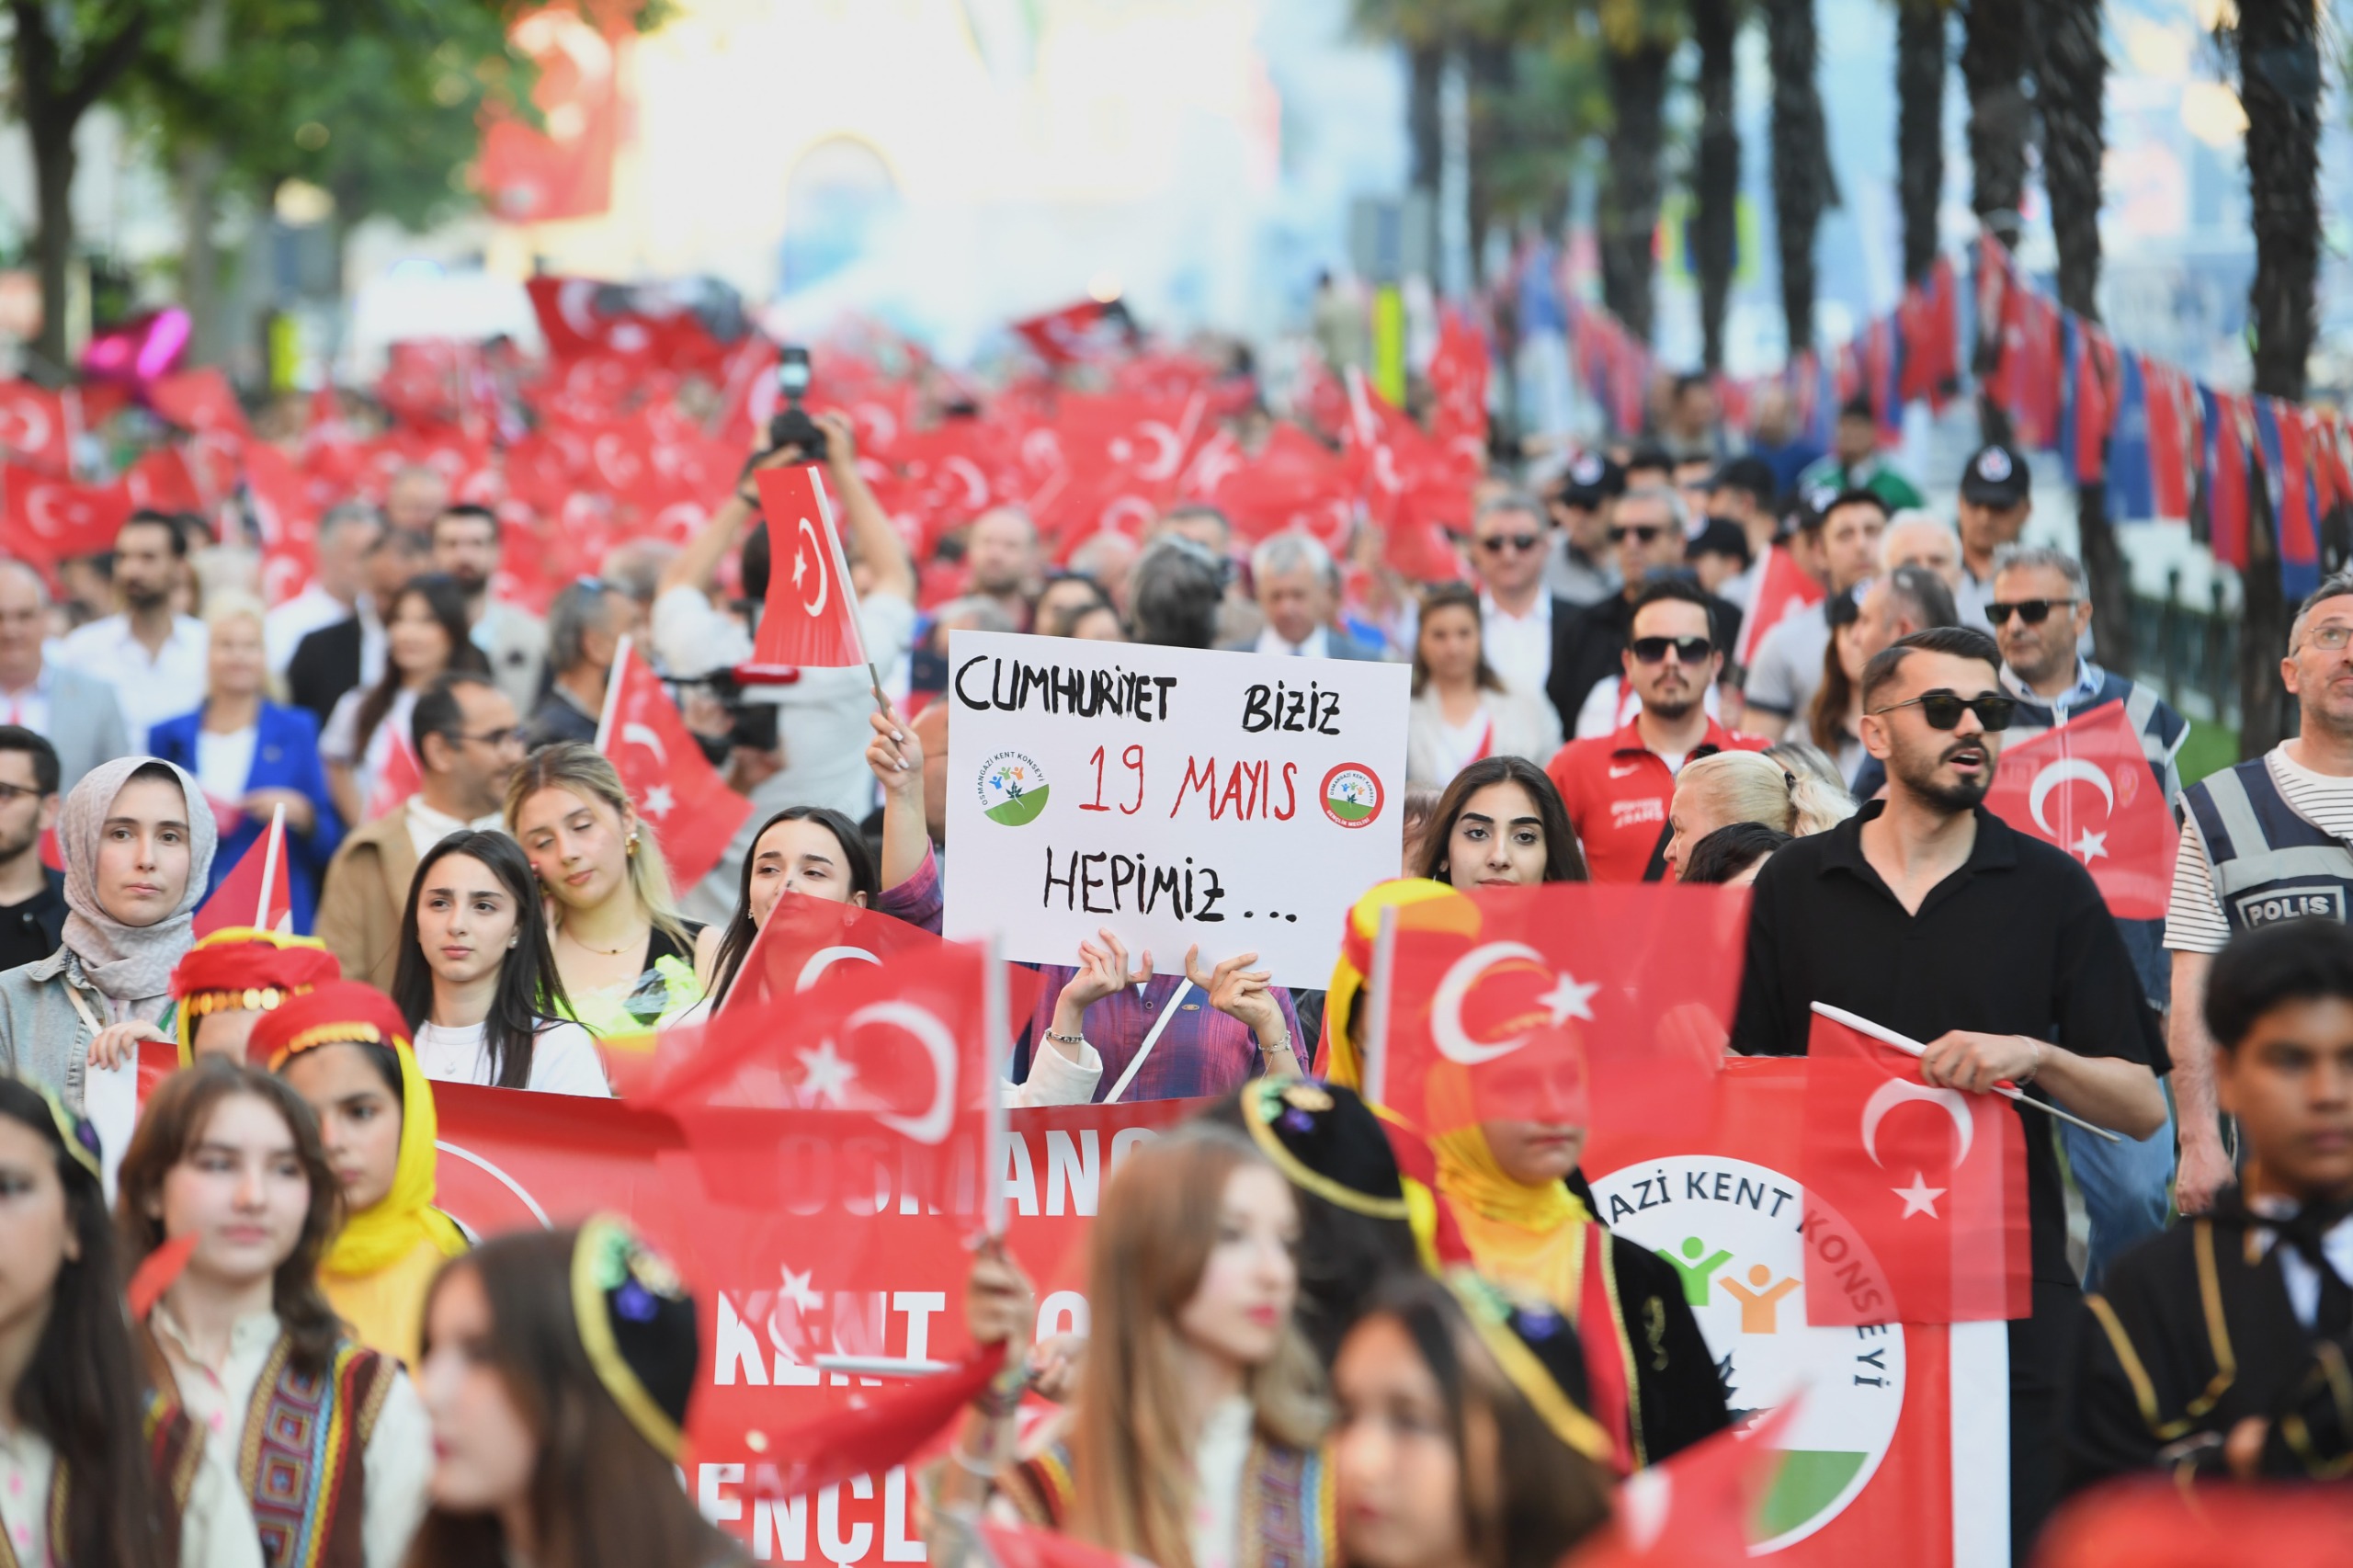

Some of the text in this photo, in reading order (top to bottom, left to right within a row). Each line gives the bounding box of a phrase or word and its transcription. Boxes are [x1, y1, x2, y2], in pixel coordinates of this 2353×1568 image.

[955, 655, 1341, 735] CUMHURİYET BİZİZ
[977, 751, 1046, 806] OSMANGAZİ KENT KONSEYİ
[1078, 744, 1298, 822] 19 MAYIS
[1608, 1168, 1892, 1389] AZİ KENT KONSEYİ
[714, 1290, 946, 1387] KENT
